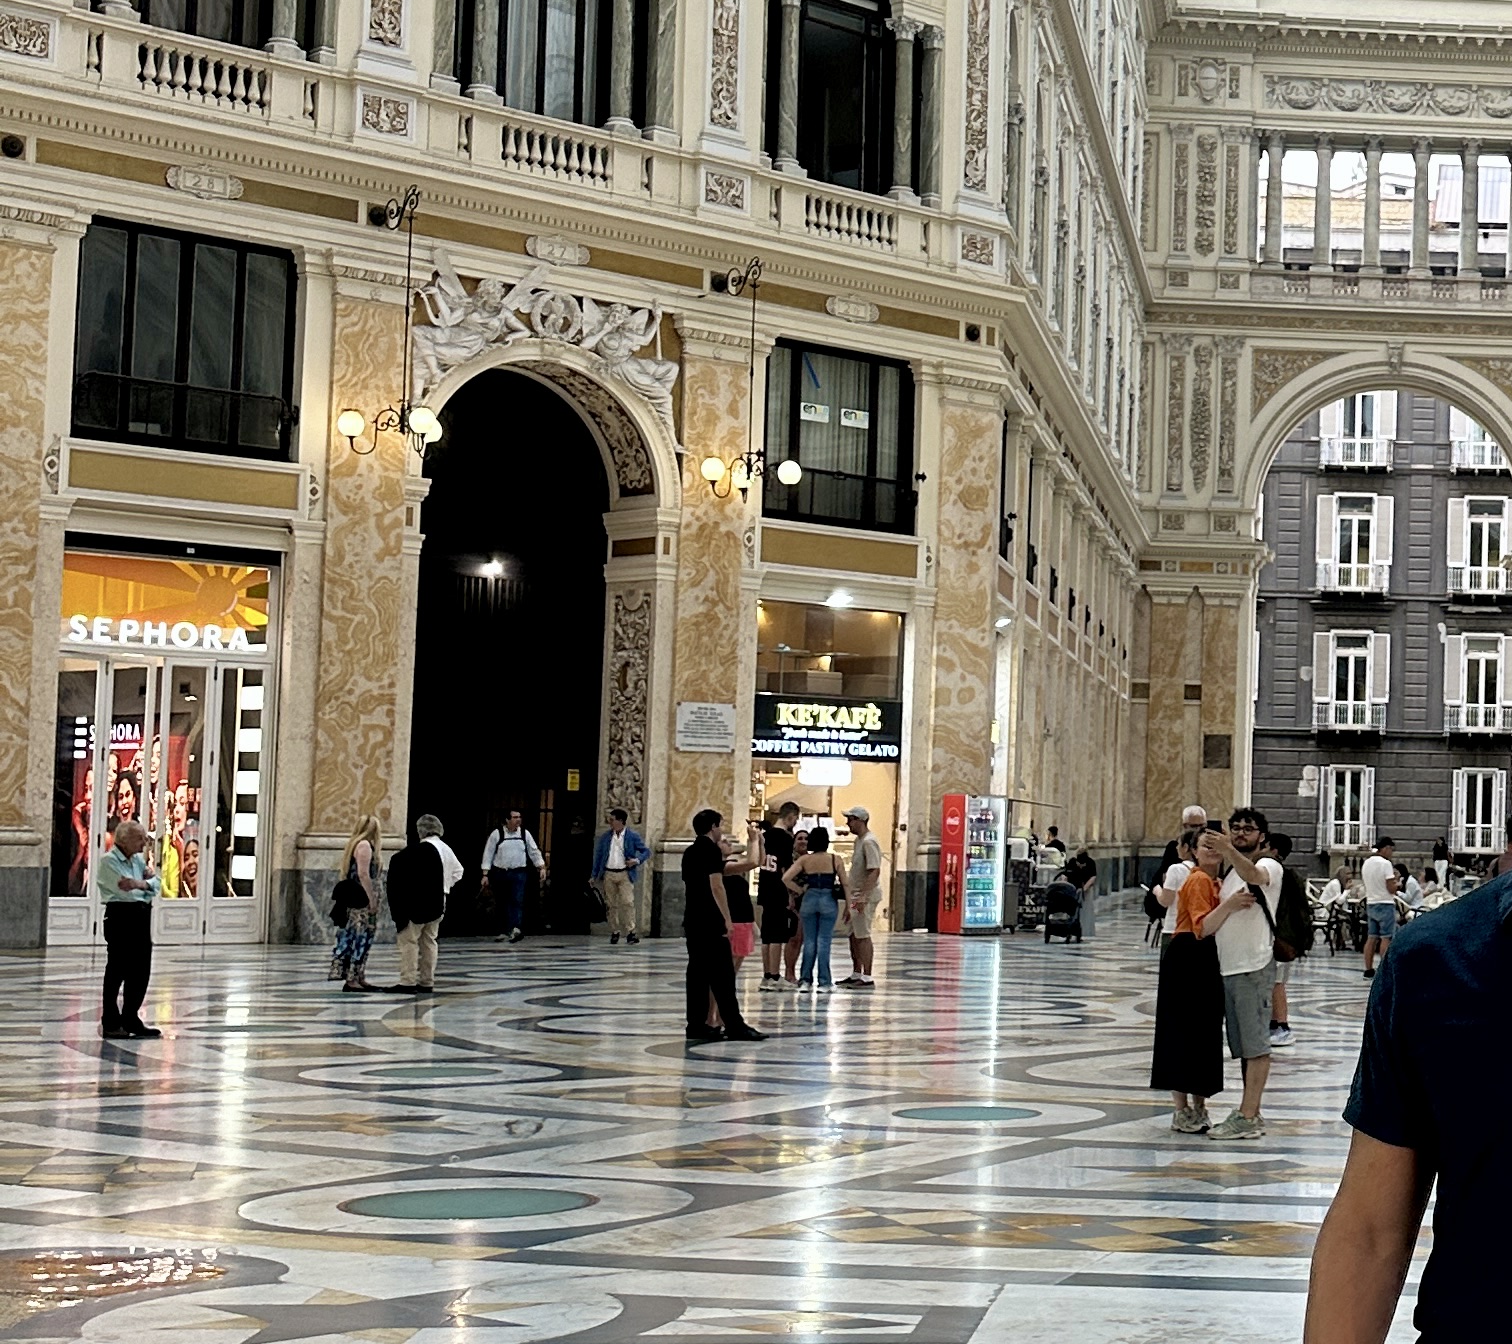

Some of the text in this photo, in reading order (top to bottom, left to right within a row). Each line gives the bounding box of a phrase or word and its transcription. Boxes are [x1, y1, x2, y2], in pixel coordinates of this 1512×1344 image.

[192, 174, 215, 190] 28
[547, 244, 567, 257] 27
[68, 613, 250, 652] SEPHORA
[89, 723, 141, 742] SHORA
[800, 741, 848, 756] PASTRY
[849, 743, 899, 757] GELATO
[1025, 894, 1036, 906] K
